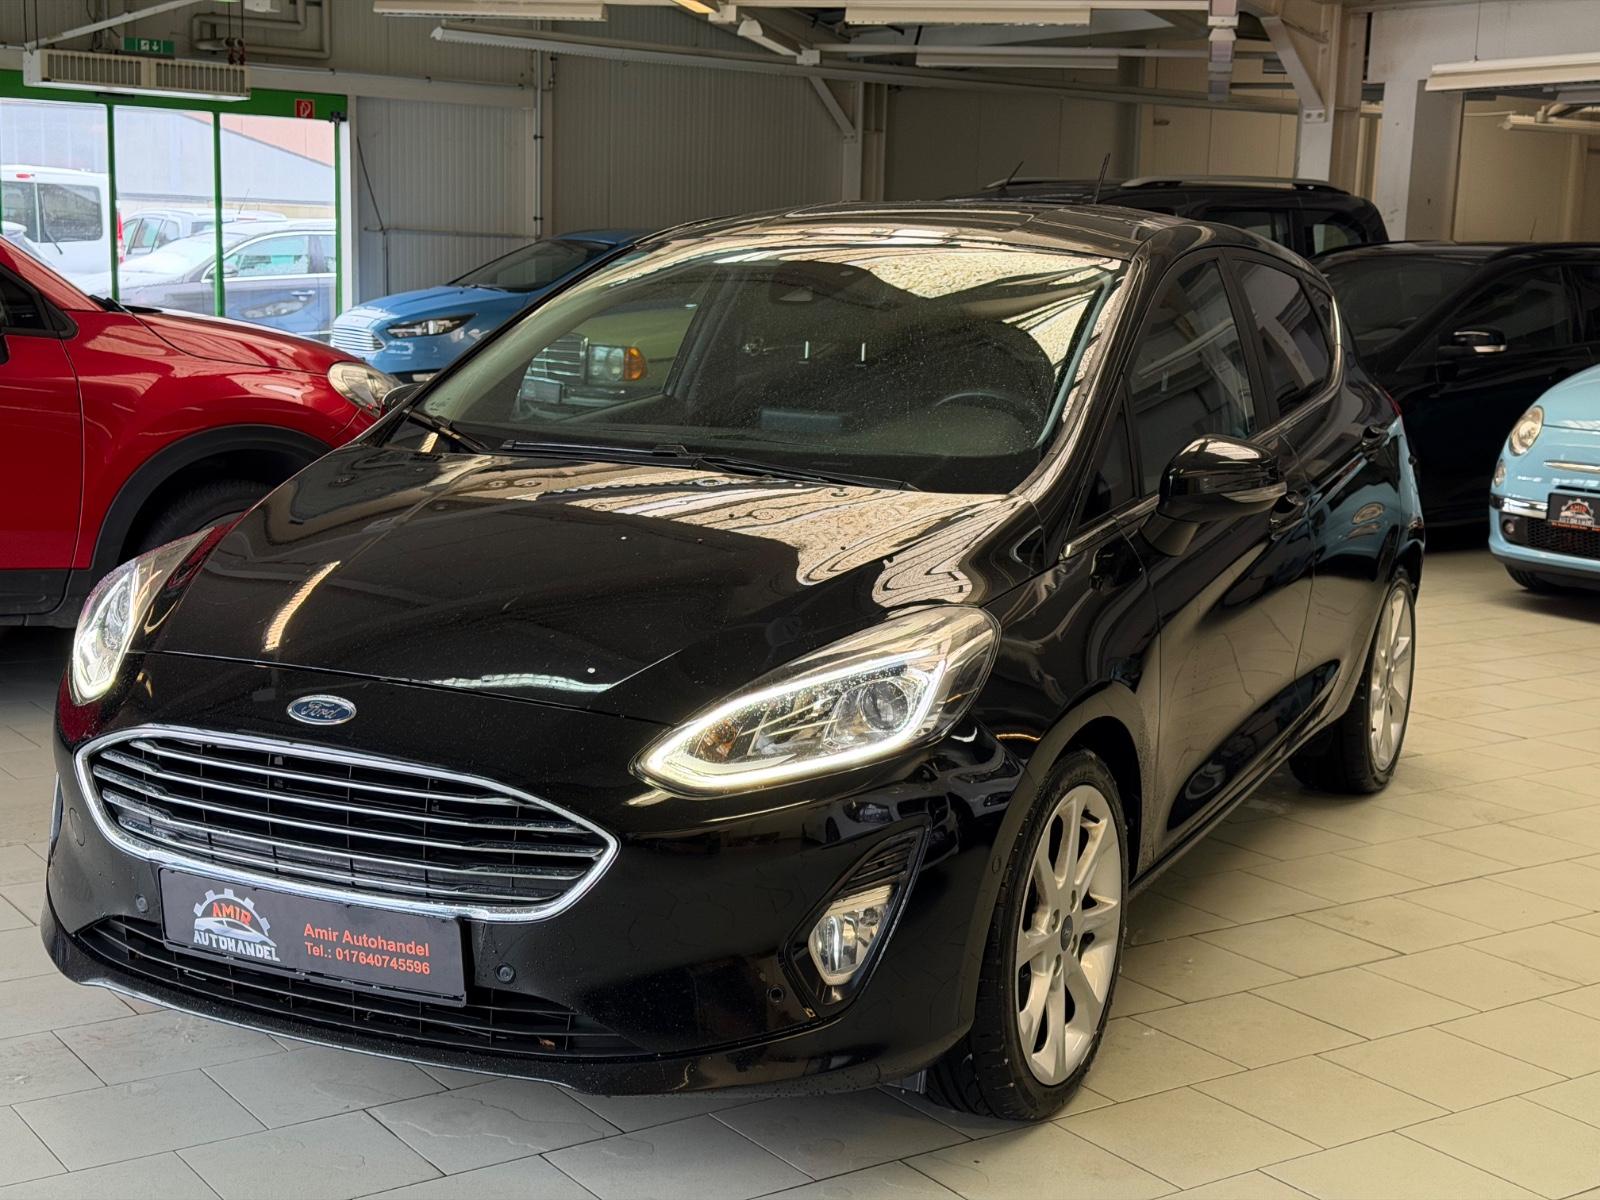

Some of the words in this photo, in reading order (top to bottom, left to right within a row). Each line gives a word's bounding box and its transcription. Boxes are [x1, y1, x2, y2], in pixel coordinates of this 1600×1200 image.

[301, 700, 342, 719] Ford
[212, 902, 252, 926] AMIR
[193, 930, 281, 962] AUTOHANDEL
[304, 923, 339, 942] Amir
[342, 930, 430, 957] Autohandel
[304, 941, 332, 959] Tel.:
[335, 947, 431, 975] 017640745596
